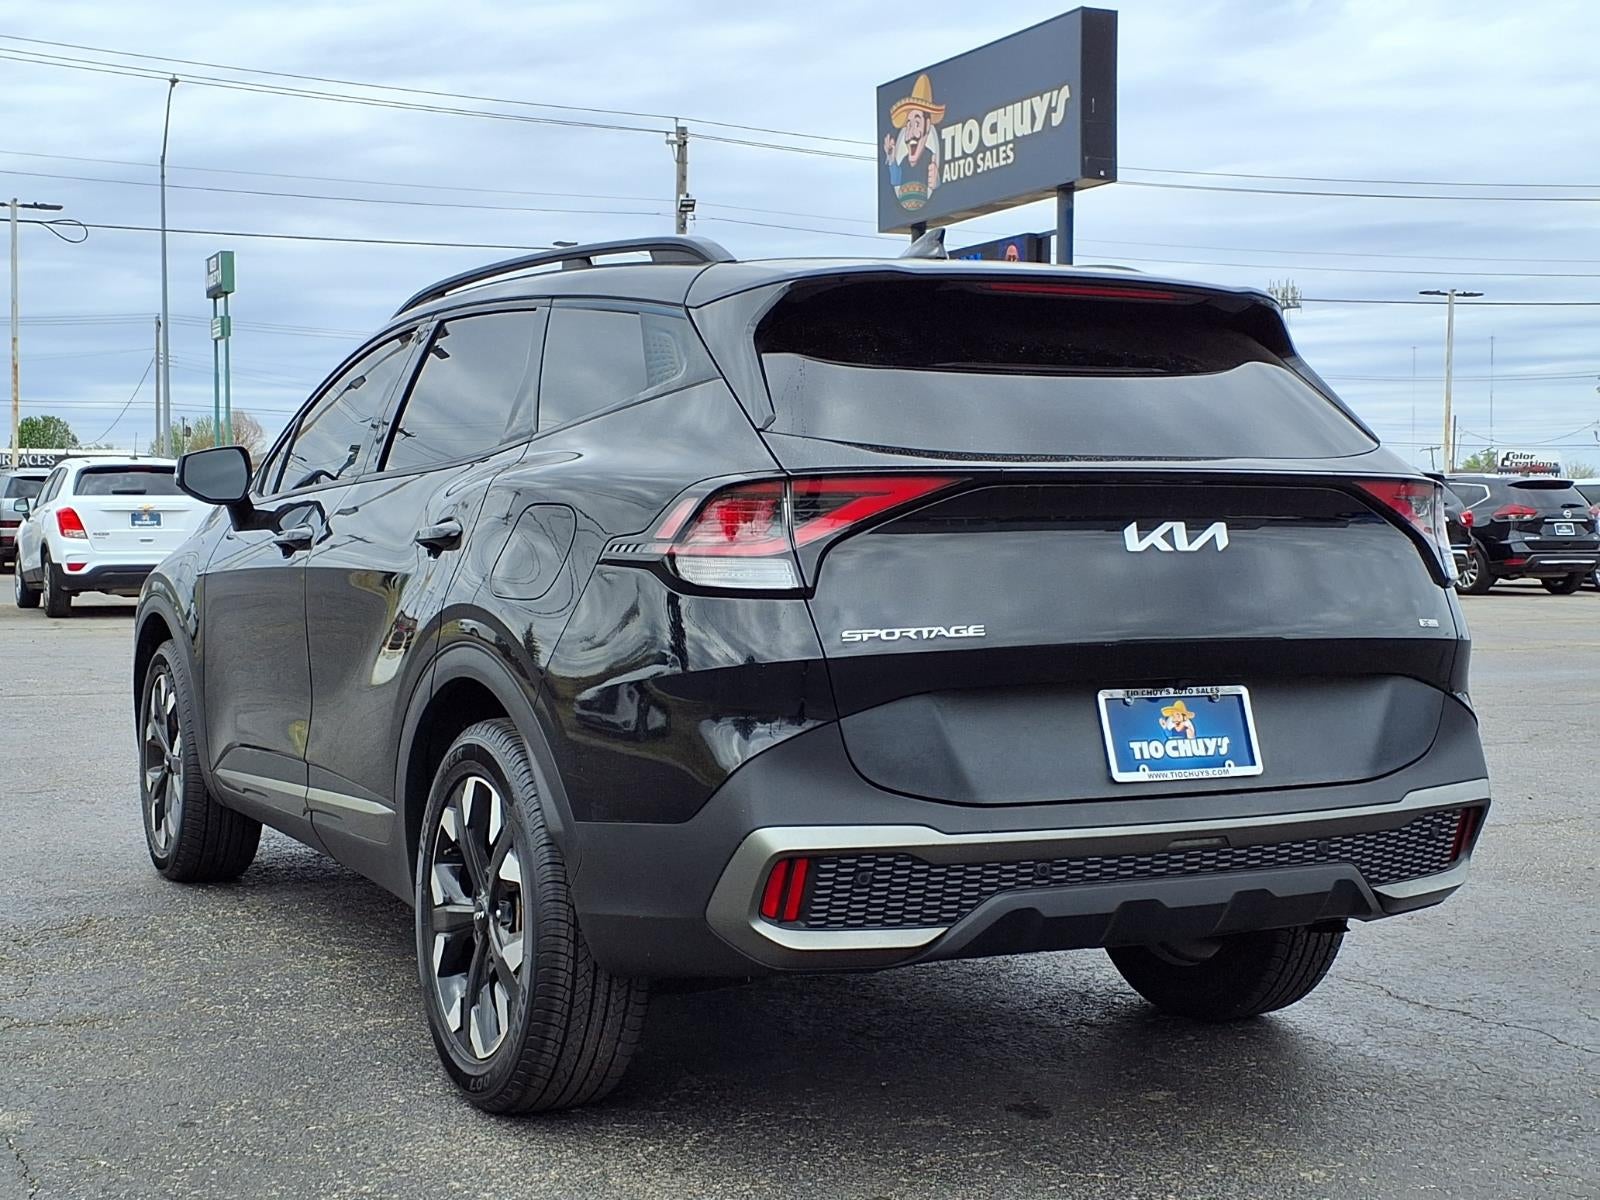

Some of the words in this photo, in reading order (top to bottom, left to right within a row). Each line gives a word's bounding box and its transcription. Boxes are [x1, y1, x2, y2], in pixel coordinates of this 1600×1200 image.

[941, 119, 980, 161] TIO
[982, 85, 1071, 148] CHUY'S
[942, 157, 973, 184] AUTO
[977, 143, 1015, 173] SALES
[1505, 451, 1536, 461] Color
[1123, 520, 1229, 552] KIA
[841, 624, 986, 642] SPORTAGE
[1173, 687, 1193, 695] AUTO
[1129, 740, 1165, 760] TIO
[1165, 736, 1230, 758] CHUY'S
[1147, 769, 1230, 779] WWW.TIOCHUYS.COM
